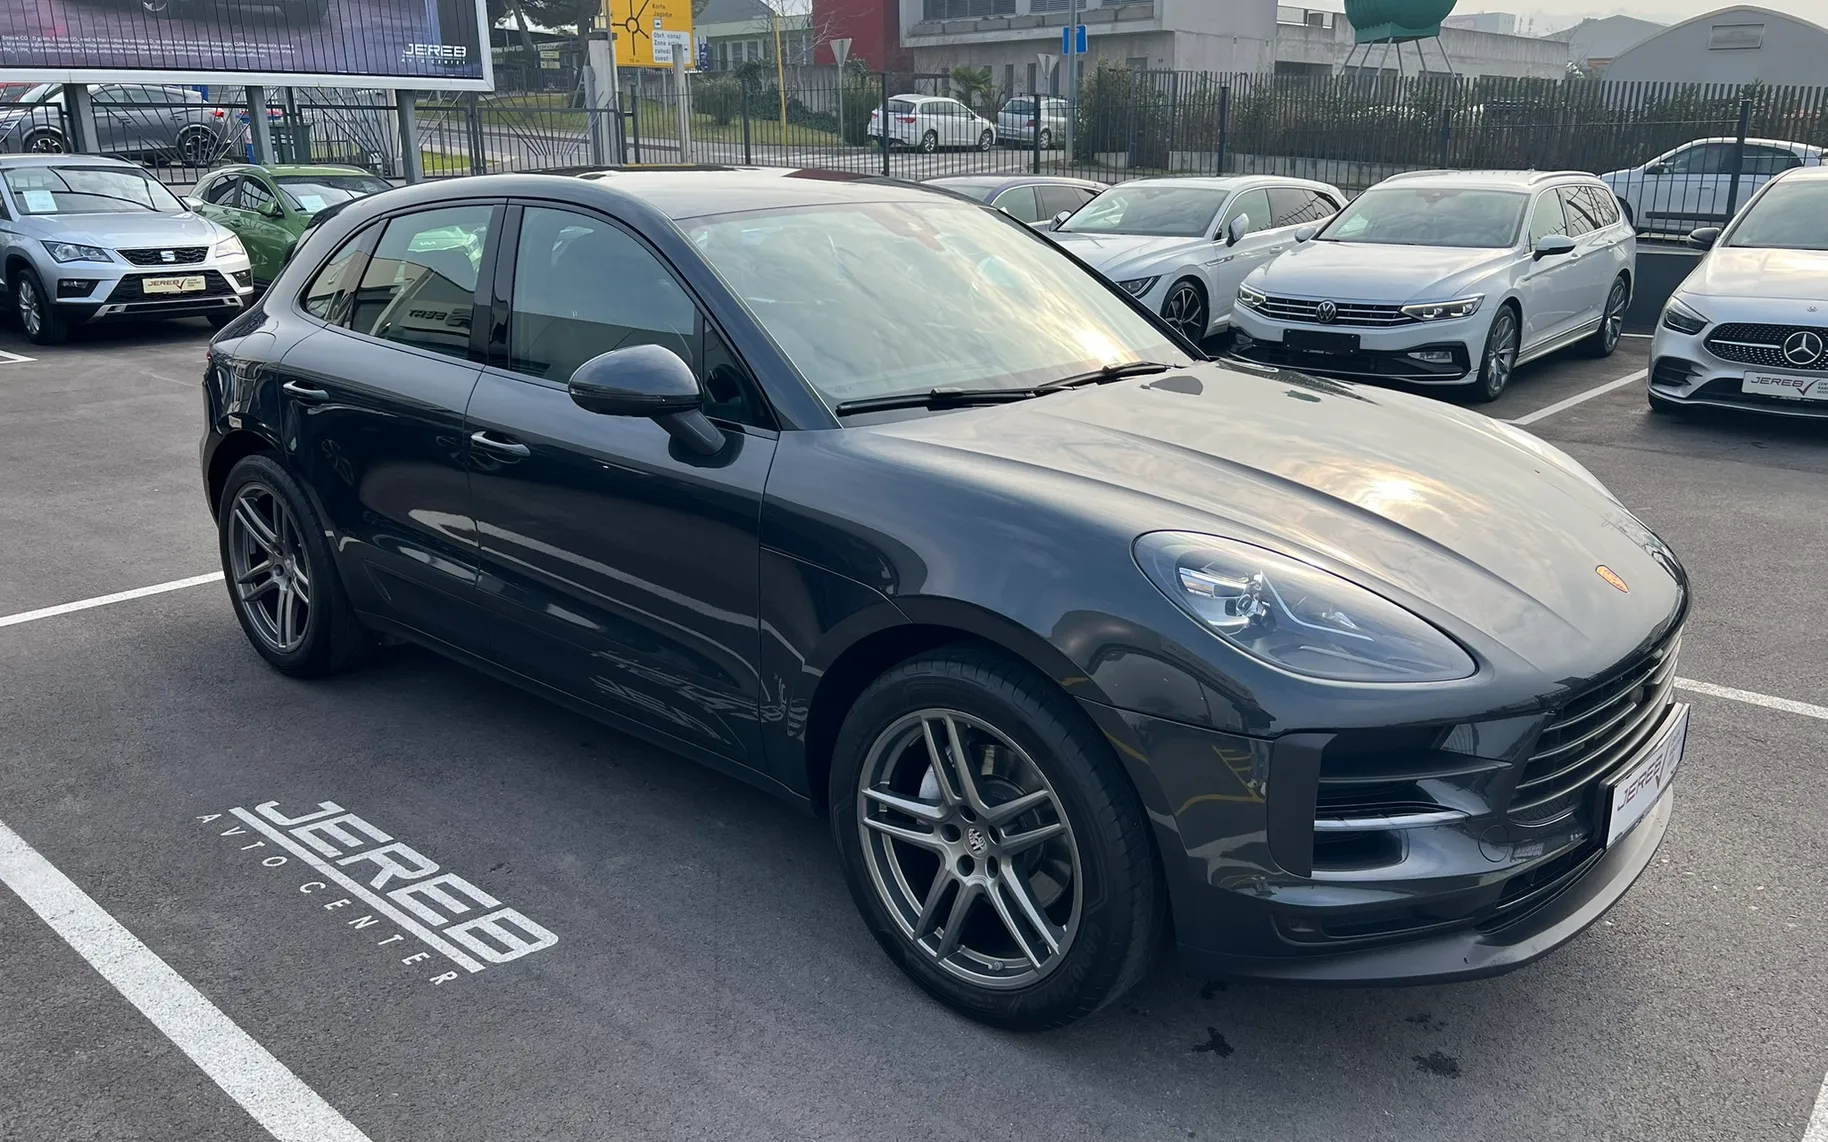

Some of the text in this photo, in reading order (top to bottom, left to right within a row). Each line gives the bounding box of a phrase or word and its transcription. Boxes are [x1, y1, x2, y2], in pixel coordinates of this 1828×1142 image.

[402, 43, 467, 57] JEREB
[148, 279, 180, 287] JEREB
[1751, 377, 1803, 387] JEREB
[1617, 753, 1663, 811] JEREB
[196, 813, 458, 985] AVTO CENTER
[255, 800, 559, 964] JEREB
